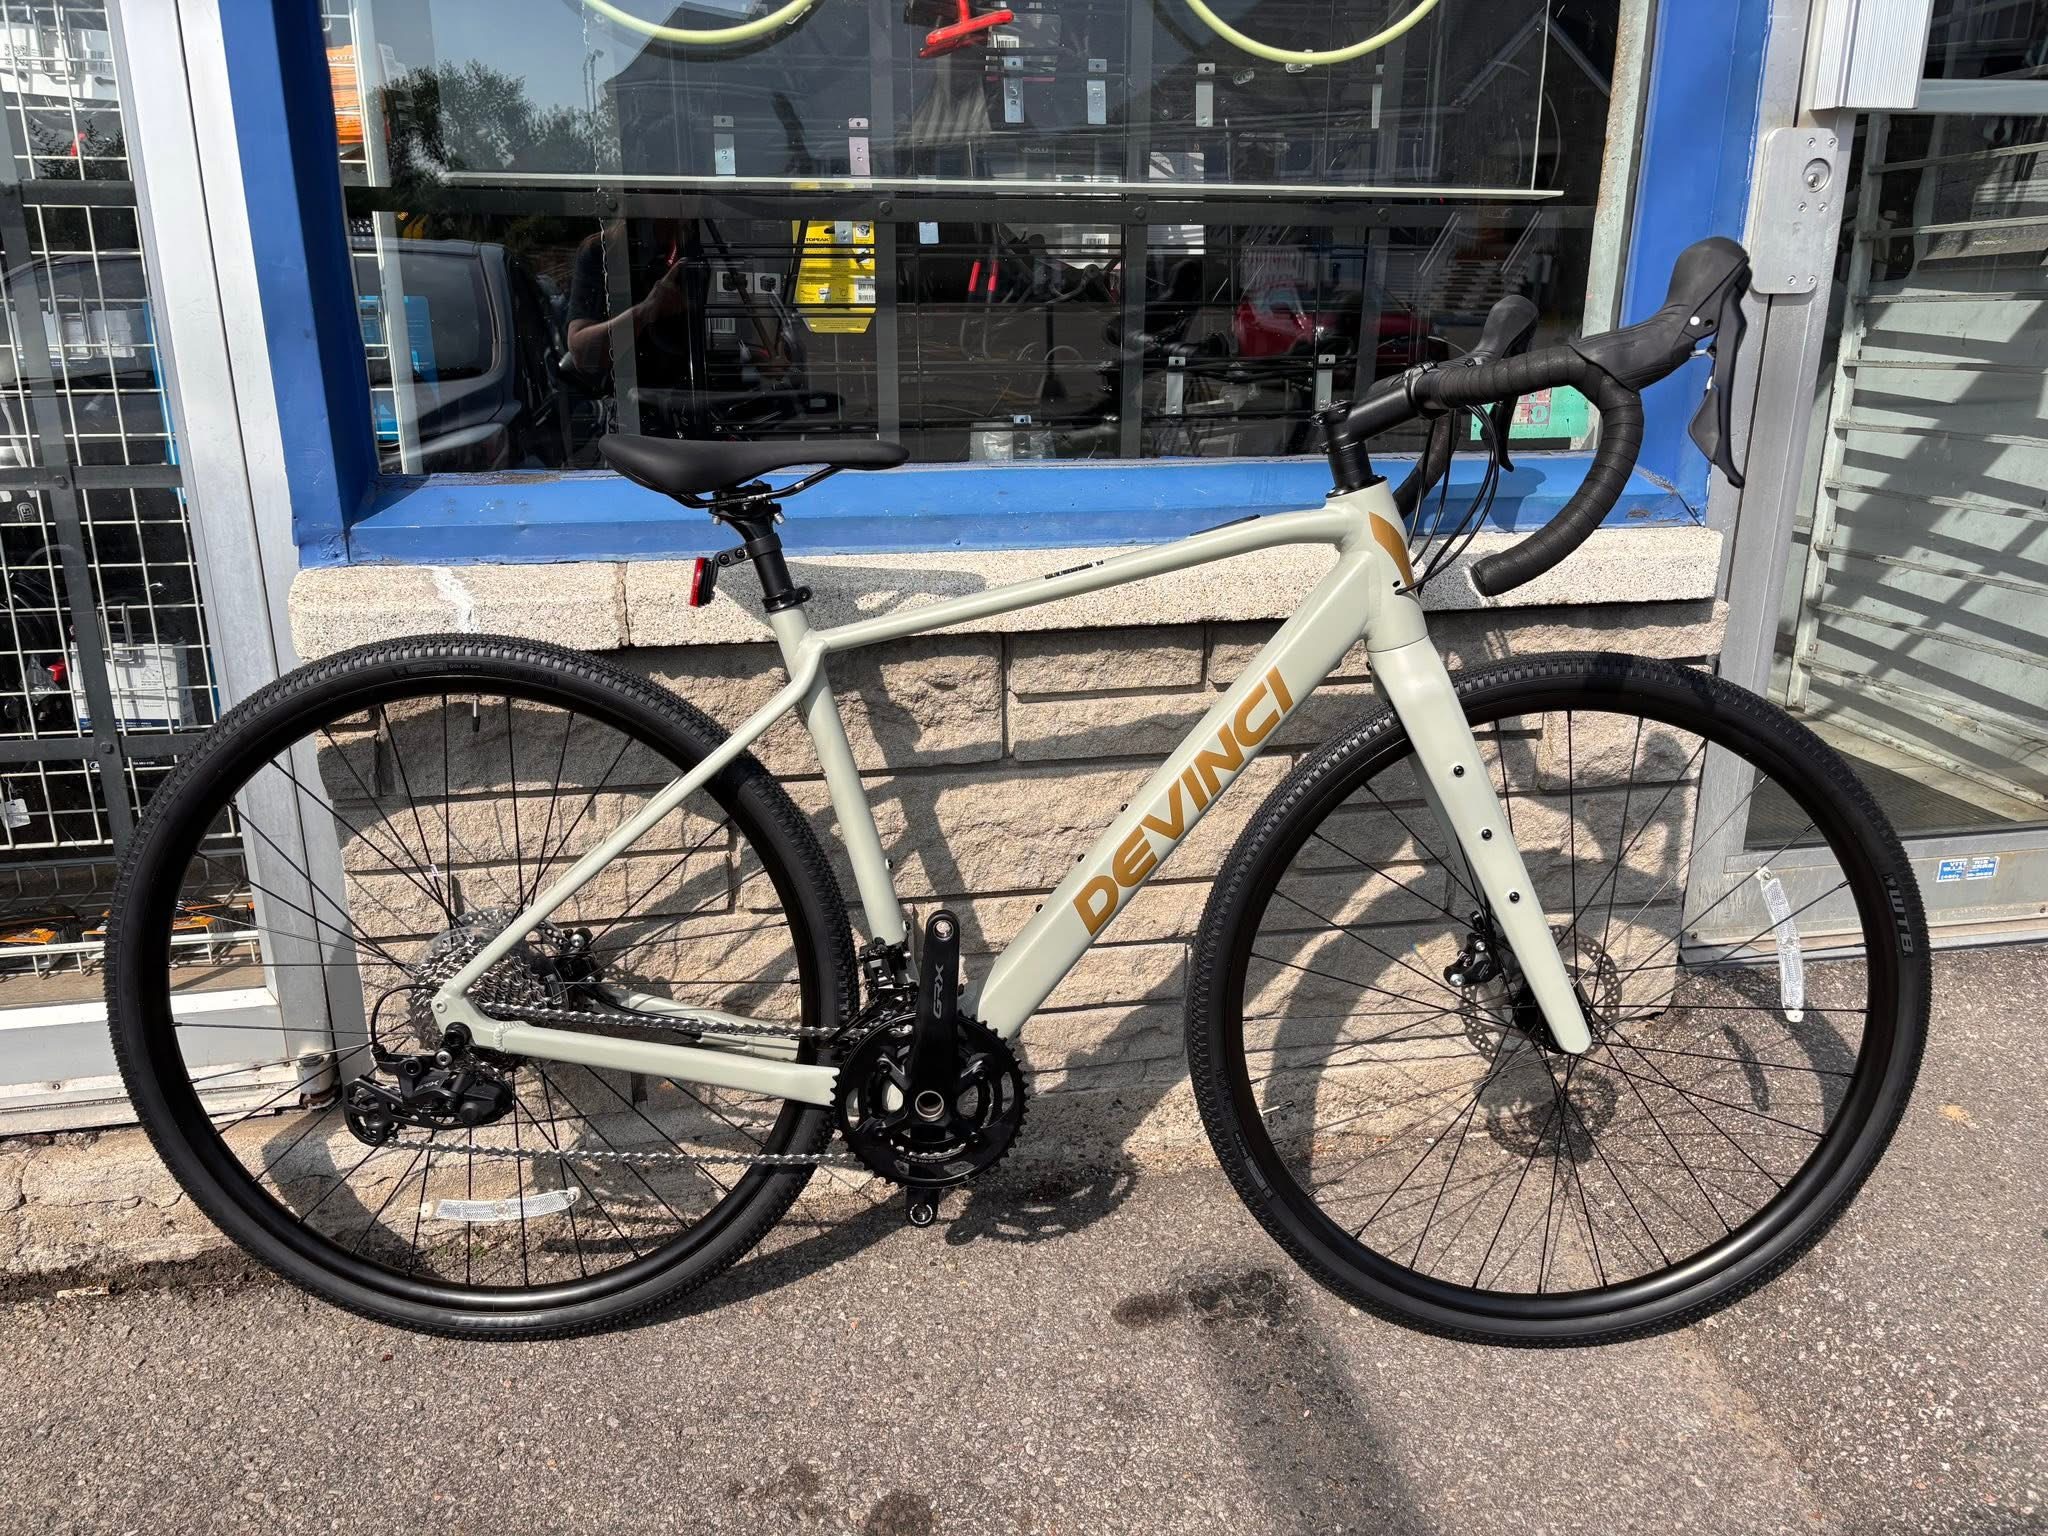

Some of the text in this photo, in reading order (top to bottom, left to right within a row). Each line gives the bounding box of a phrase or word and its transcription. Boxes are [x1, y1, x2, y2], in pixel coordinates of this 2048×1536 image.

[1073, 665, 1293, 936] DEVINCI
[1888, 889, 1914, 953] WTB
[933, 963, 944, 1019] GRX
